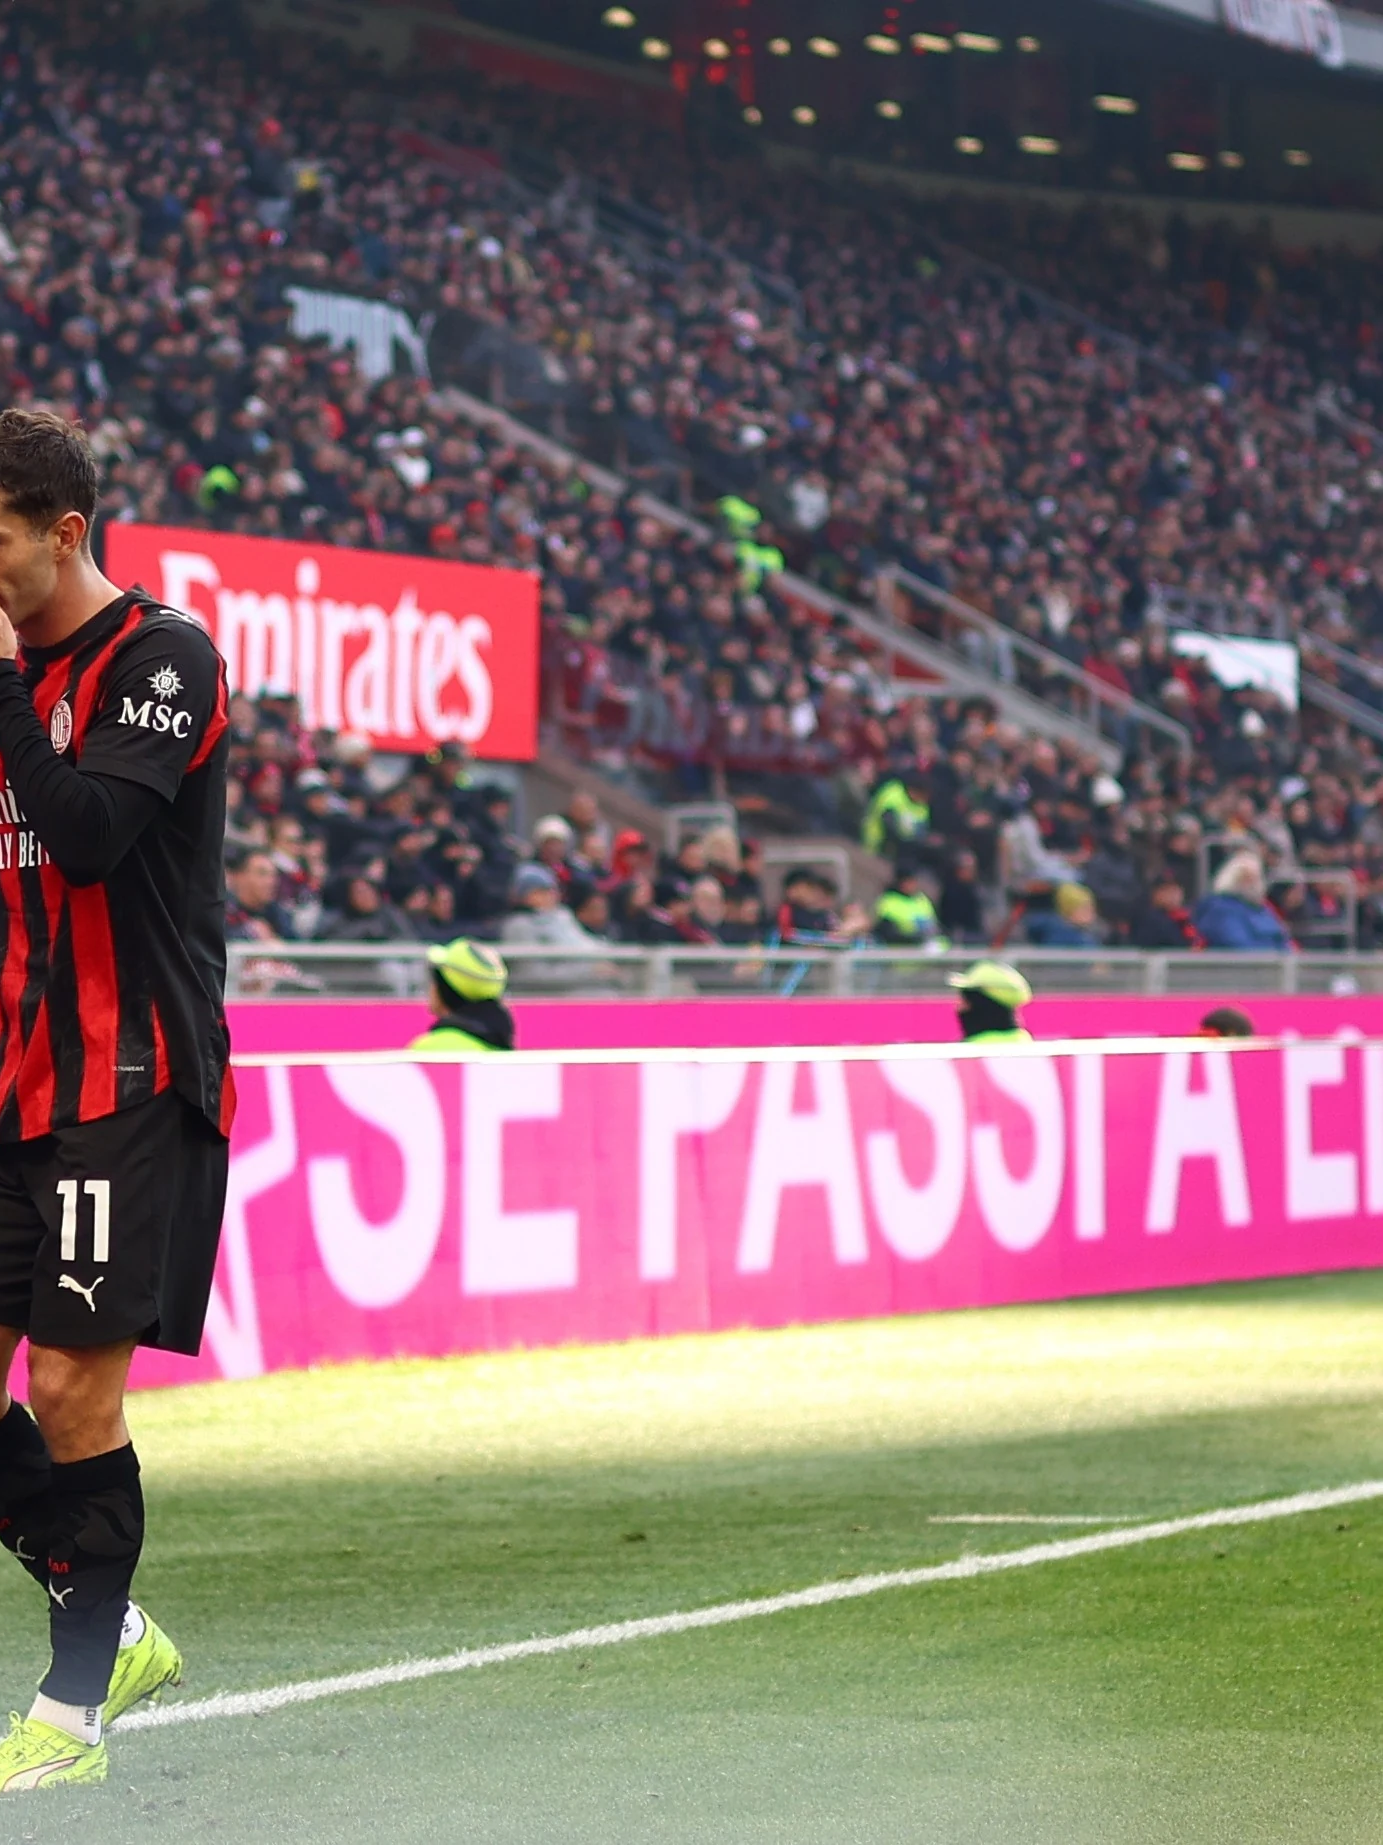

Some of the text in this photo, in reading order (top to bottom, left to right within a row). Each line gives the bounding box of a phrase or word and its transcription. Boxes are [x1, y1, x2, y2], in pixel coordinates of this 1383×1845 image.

[118, 697, 192, 738] MSC
[638, 1050, 1107, 1281] PASSI
[1144, 1050, 1252, 1235] A
[56, 1180, 110, 1262] 11
